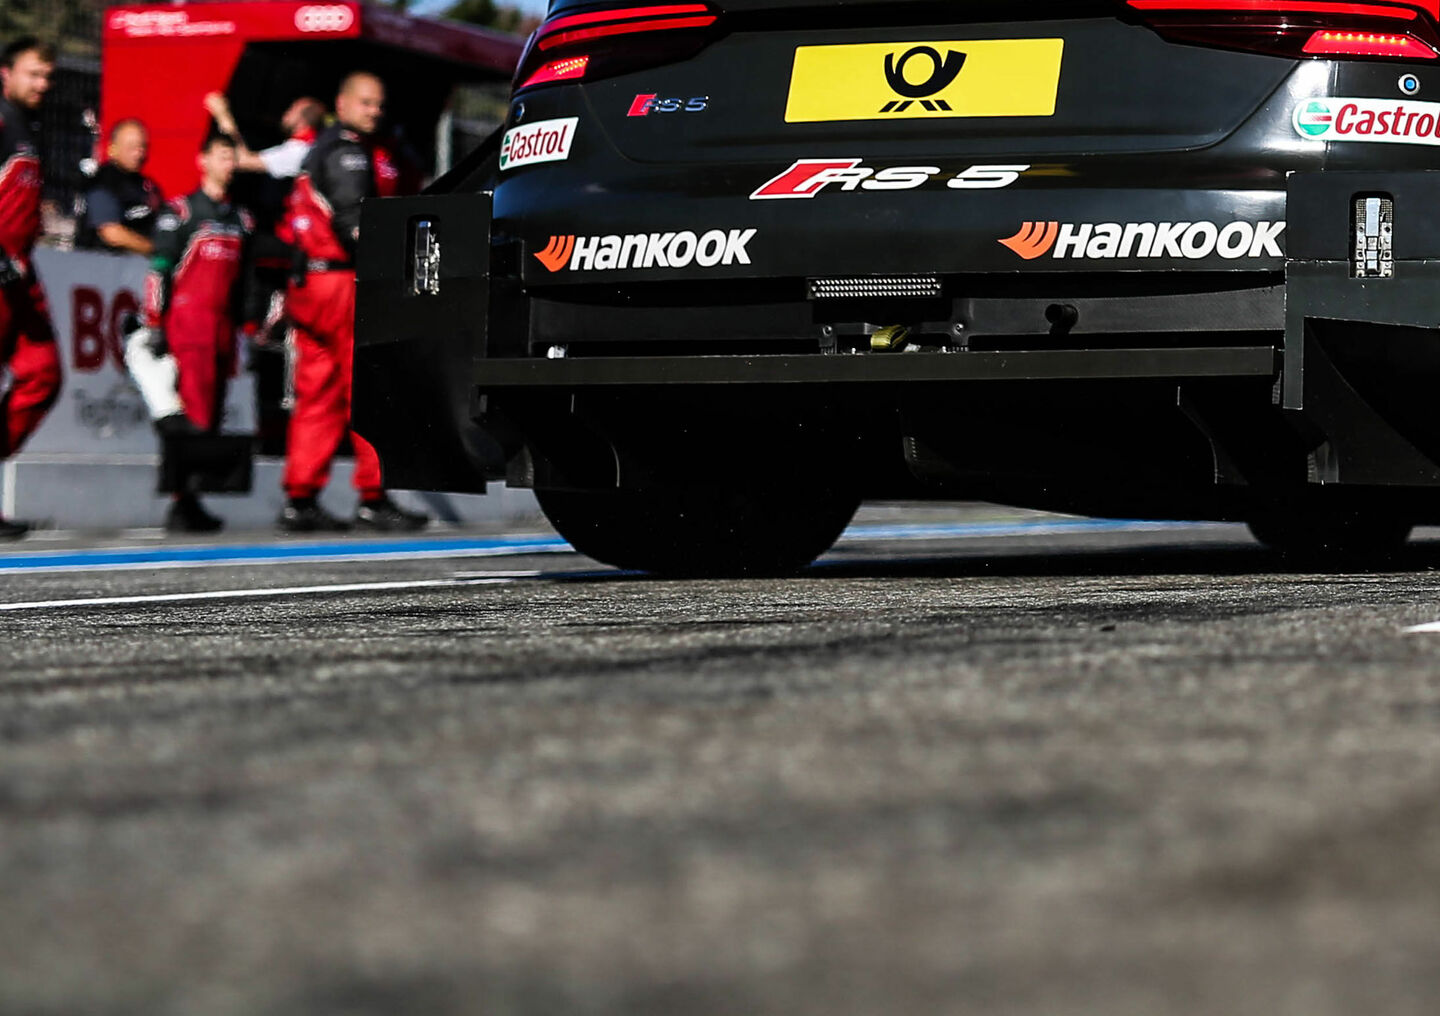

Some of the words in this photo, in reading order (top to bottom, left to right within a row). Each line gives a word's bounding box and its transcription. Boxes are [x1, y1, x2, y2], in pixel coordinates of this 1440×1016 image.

[685, 96, 709, 112] 5
[508, 124, 570, 163] Castrol
[785, 164, 941, 194] RS
[947, 164, 1031, 189] 5
